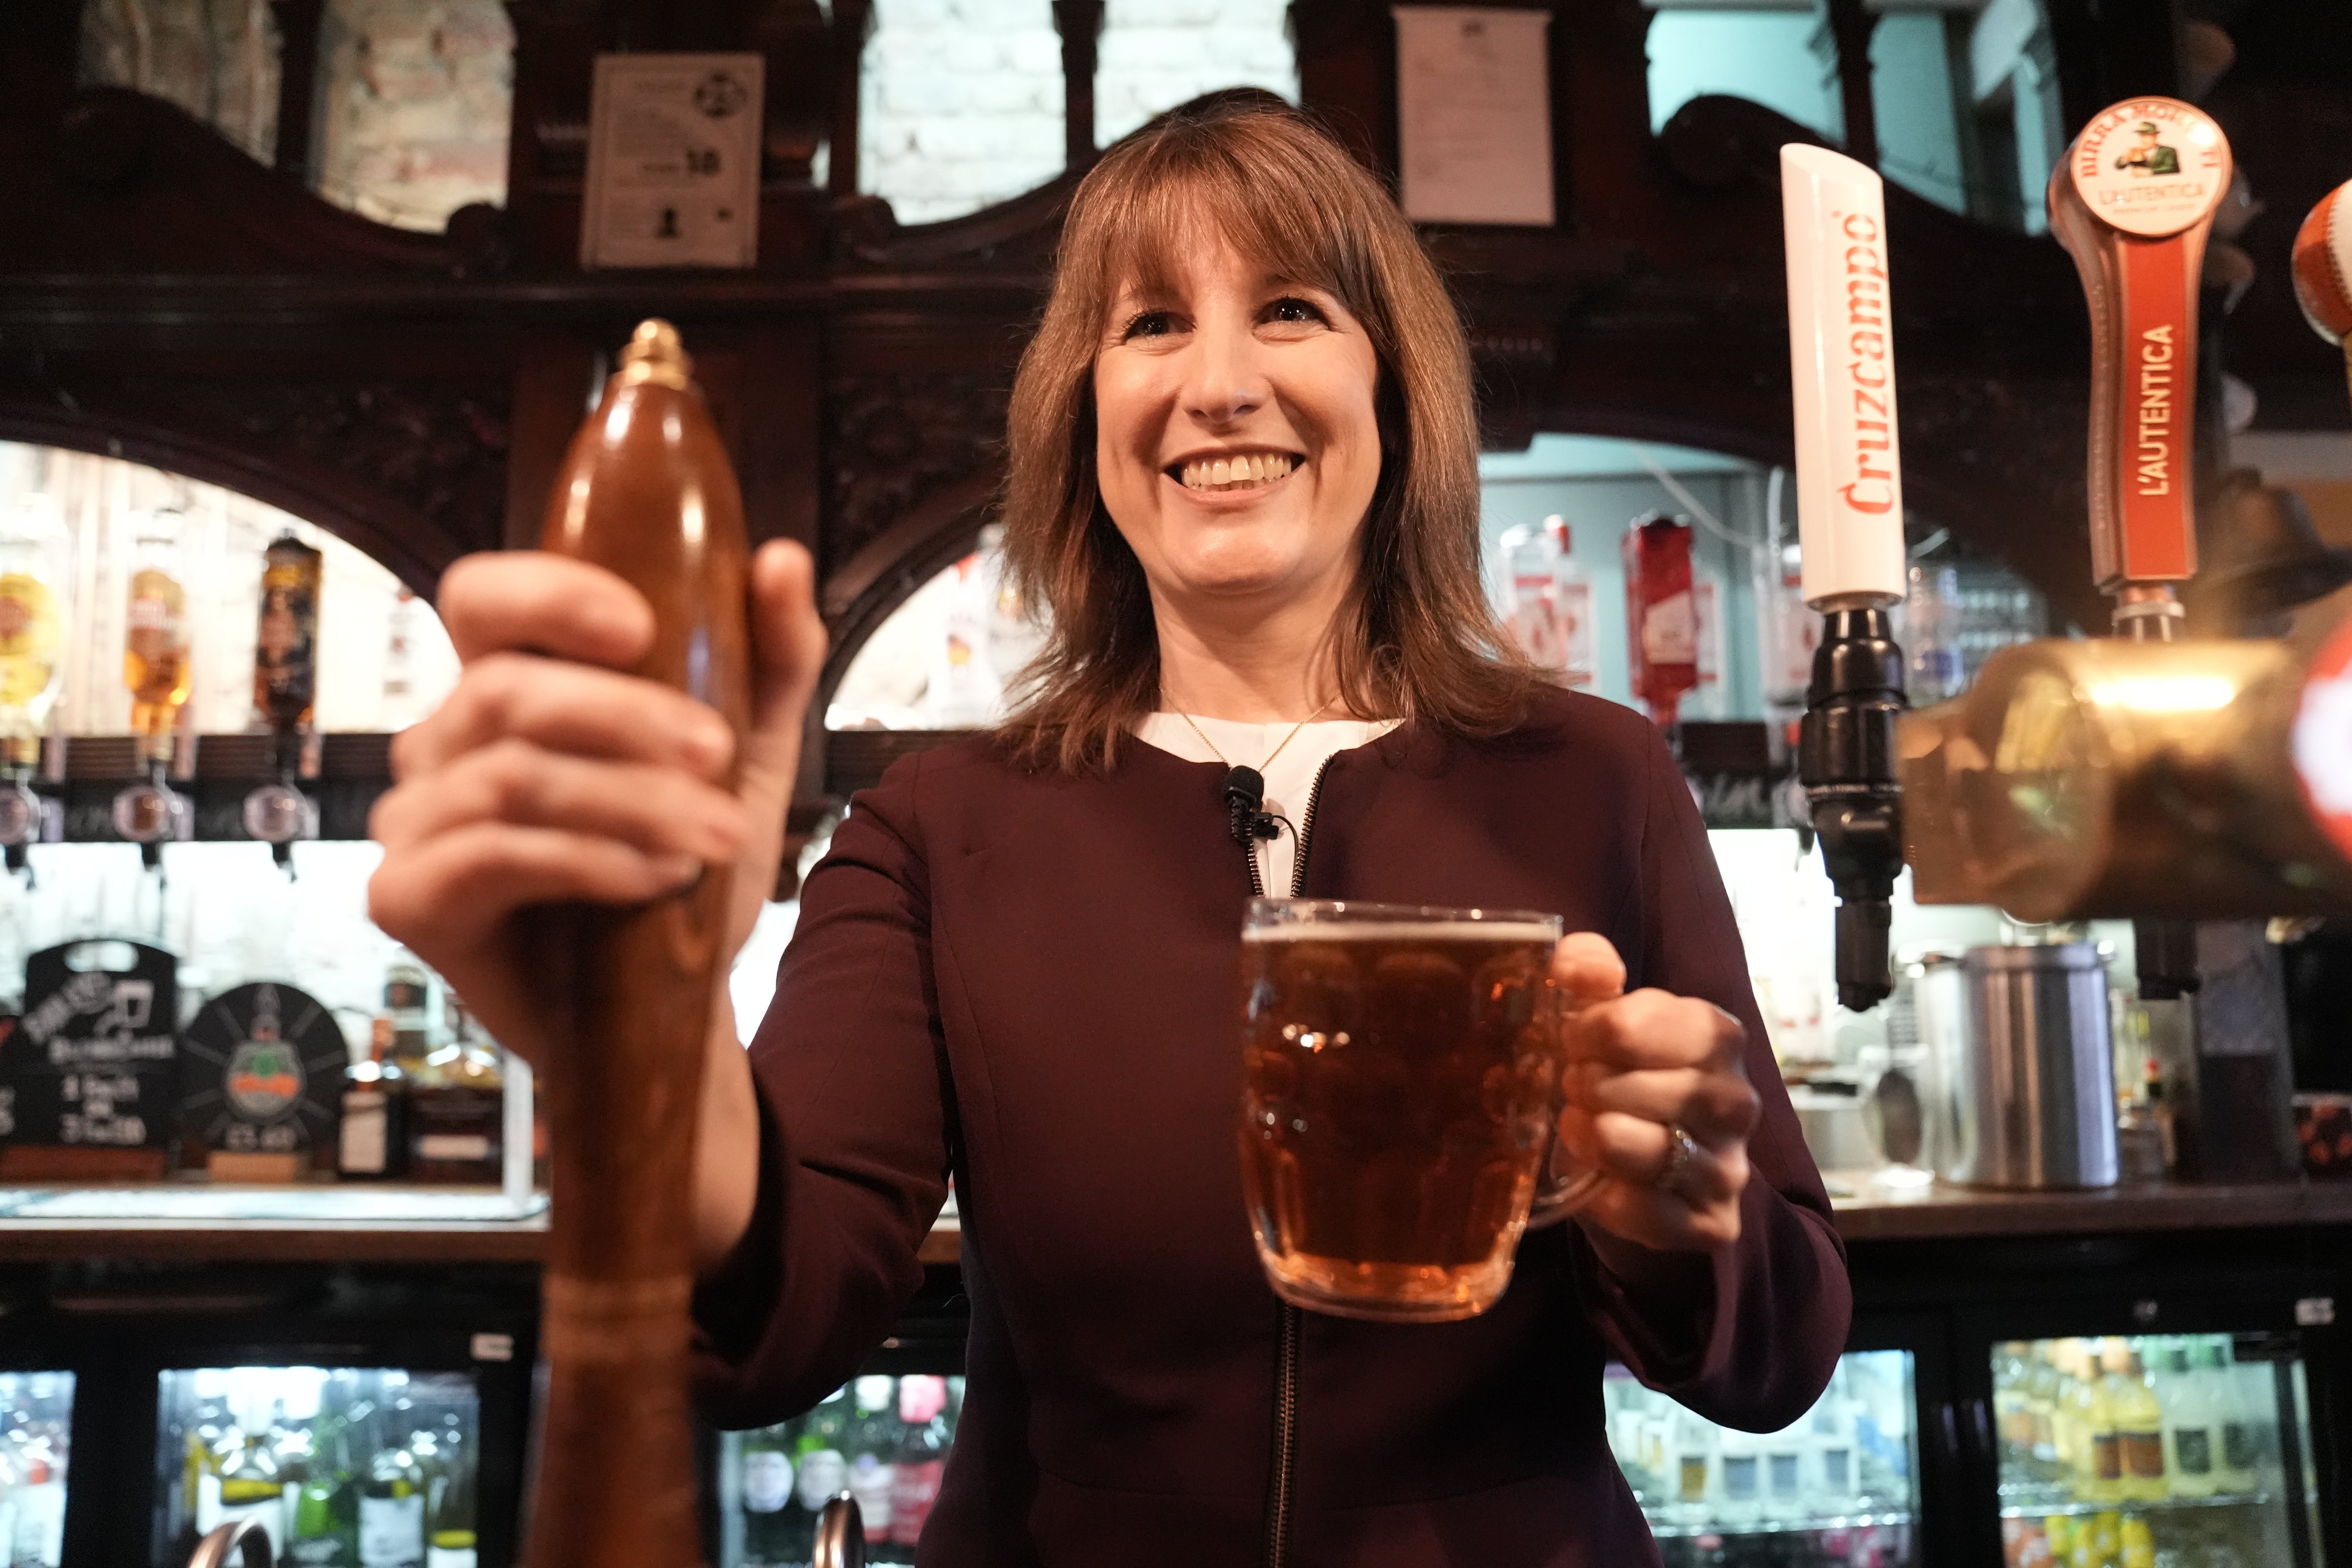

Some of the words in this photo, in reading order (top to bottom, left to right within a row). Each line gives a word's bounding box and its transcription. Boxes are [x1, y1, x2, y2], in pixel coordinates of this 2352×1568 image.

[2081, 114, 2126, 177] BIRRA
[1837, 212, 1894, 515] Cruzcampo
[2138, 324, 2174, 496] L'AUTENTICA
